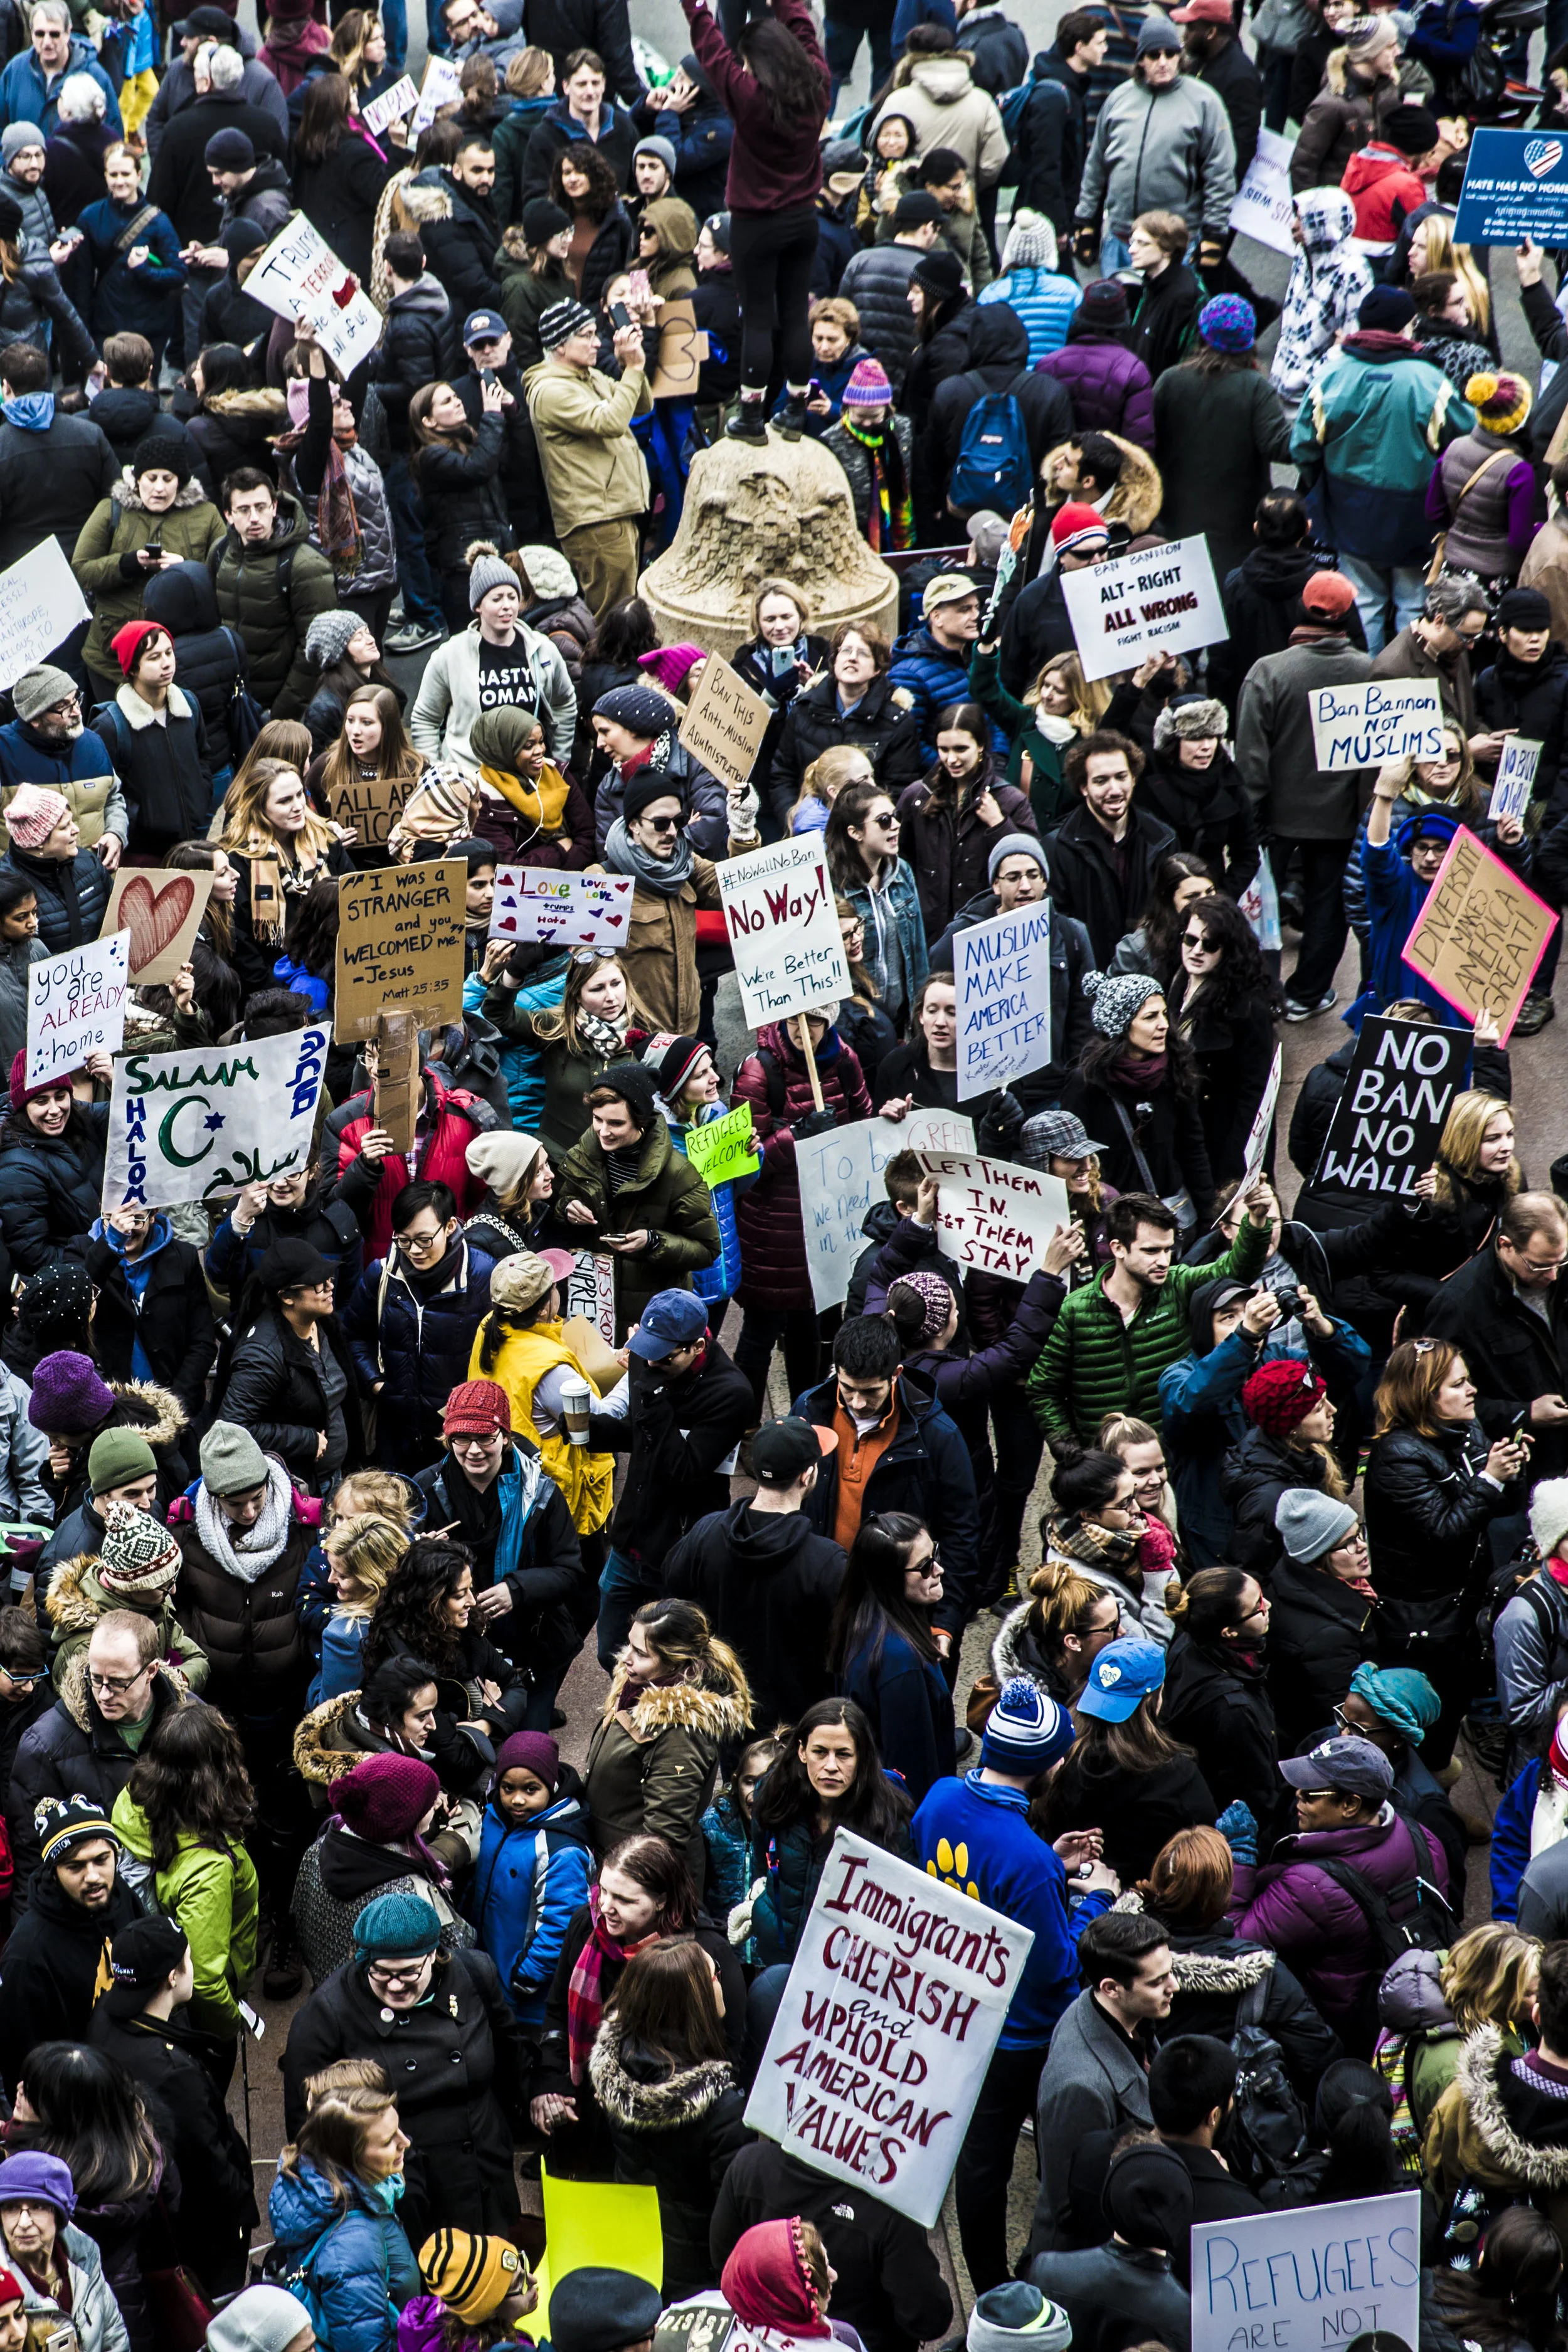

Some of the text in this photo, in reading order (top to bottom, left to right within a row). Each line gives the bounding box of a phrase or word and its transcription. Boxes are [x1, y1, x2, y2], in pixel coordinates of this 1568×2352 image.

[1466, 179, 1494, 191] HATE
[1496, 181, 1517, 192] HAS
[1519, 182, 1537, 193] NO
[289, 297, 308, 314] A
[36, 620, 53, 638] TO
[1104, 591, 1199, 633] ALL WRONG
[1117, 620, 1181, 647] FIGHT RACISM
[479, 687, 537, 706] OMAN
[733, 693, 755, 725] THIS
[1318, 686, 1436, 723] Ban Bannon
[1364, 714, 1404, 734] NOT
[1328, 727, 1442, 768] MUSLIMS
[1500, 746, 1539, 782] NO BAN
[336, 778, 416, 815] ALL AR
[396, 870, 426, 889] was
[435, 869, 445, 882] a
[347, 886, 451, 922] STRANGER
[537, 915, 567, 925] Hate
[543, 902, 575, 912] trumps
[728, 864, 829, 940] No Way!
[1414, 838, 1481, 968] DIVERSITY
[1449, 888, 1489, 953] MAKES
[395, 913, 452, 934] and you
[964, 912, 1050, 972] MUSLIMS
[343, 933, 433, 966] WELCOMED
[741, 946, 834, 988] We're Better
[1454, 888, 1520, 1004] AMERICA
[1482, 910, 1539, 1019] GREAT!
[34, 955, 86, 1006] you
[66, 971, 103, 1002] are
[382, 978, 450, 1003] Matt 25:35
[753, 960, 843, 1012] Than This!!
[964, 953, 1032, 1004] MAKE
[39, 982, 127, 1037] ALREADY
[963, 990, 1029, 1036] AMERICA
[52, 1029, 105, 1064] home
[967, 1011, 1047, 1066] BETTER
[1374, 1029, 1451, 1075] NO
[1351, 1069, 1453, 1124] BAN
[687, 1108, 750, 1157] REFUGEES
[811, 1140, 853, 1187] To
[908, 1120, 973, 1152] GREAT
[1351, 1117, 1416, 1157] NO
[920, 1153, 1042, 1197] LET THEM
[1320, 1150, 1417, 1196] WALL
[837, 1180, 871, 1221] need
[819, 1232, 838, 1254] in
[974, 1216, 1034, 1254] THEM
[960, 1239, 1030, 1276] STAY
[594, 1258, 614, 1348] DESTROY
[823, 1853, 1010, 1988] Immigrants
[822, 1925, 981, 2042] CHERISH
[801, 1990, 928, 2087] UPHOLD
[849, 1999, 915, 2039] and
[773, 2040, 953, 2148] AMERICAN
[784, 2082, 906, 2185] VALUES
[1206, 2227, 1420, 2315] REFUGEES
[1227, 2303, 1382, 2351] ARE NOT
